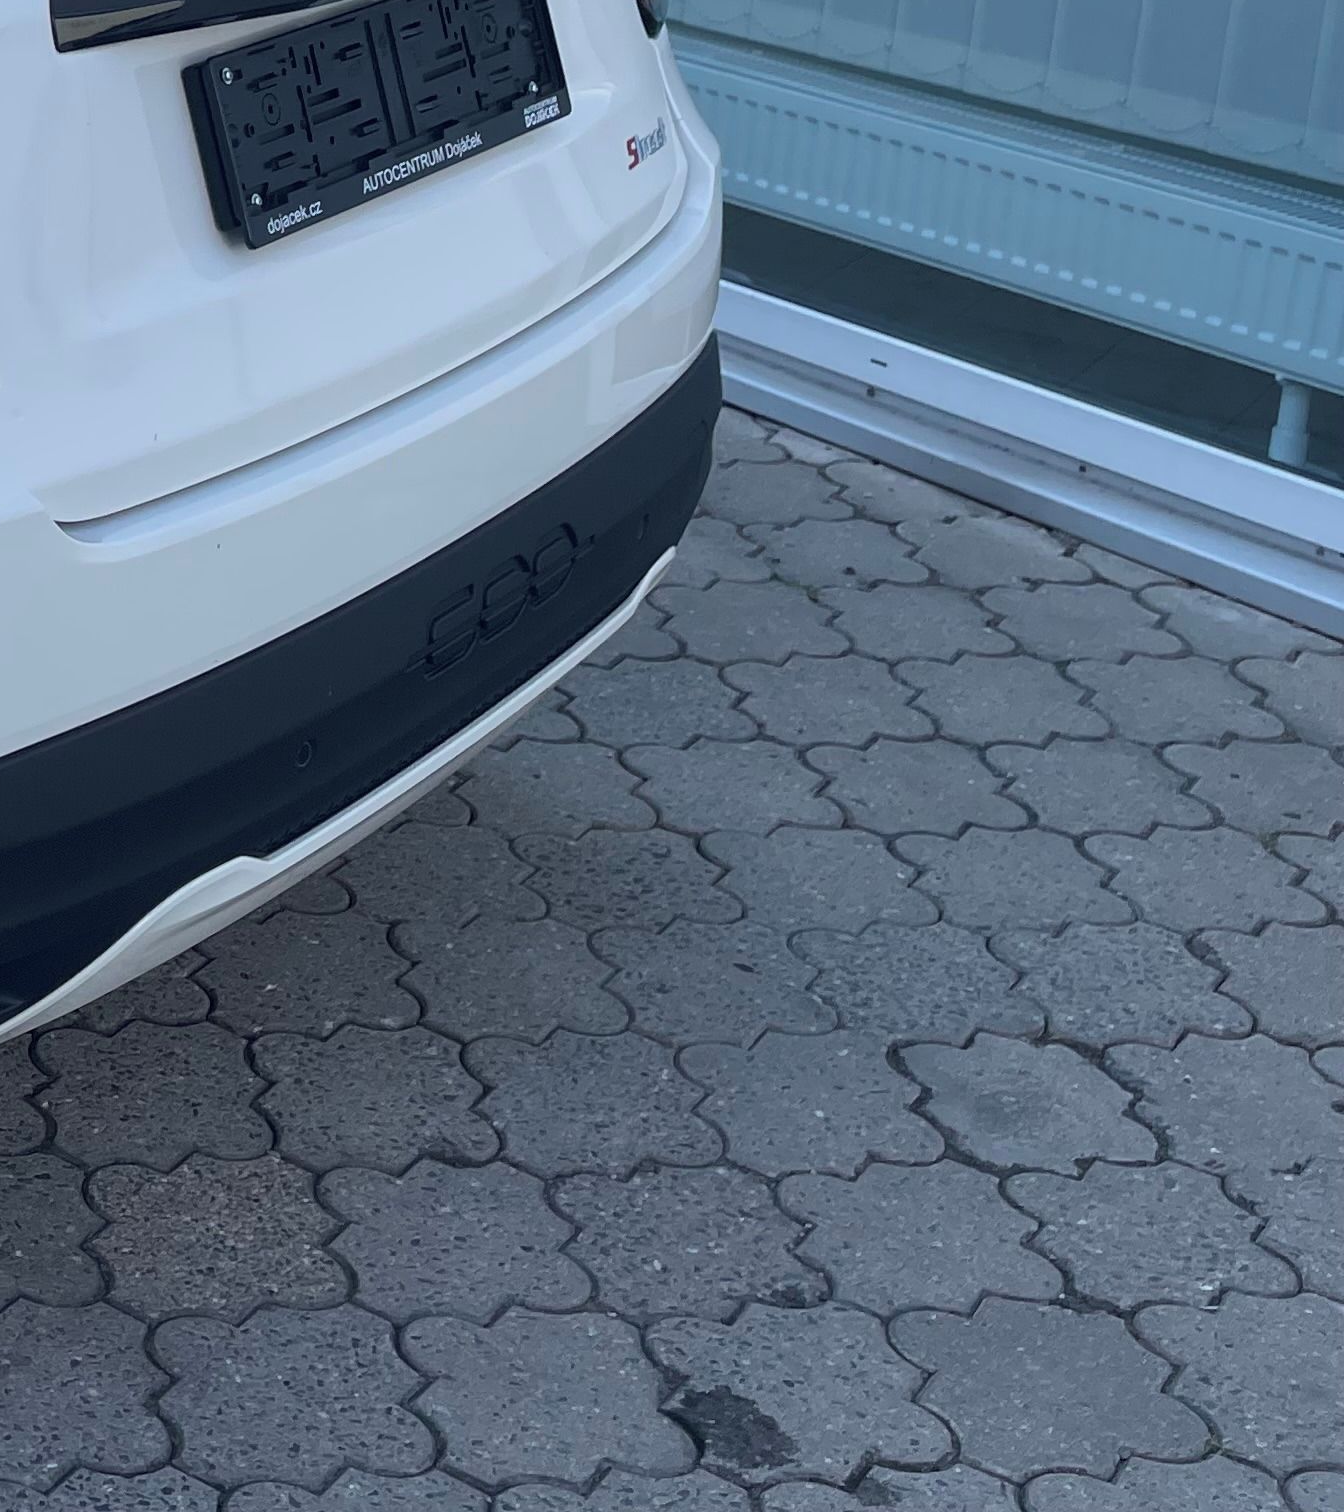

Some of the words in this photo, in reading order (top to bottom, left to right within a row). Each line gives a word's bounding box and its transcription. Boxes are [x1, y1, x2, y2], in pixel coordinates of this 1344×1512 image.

[362, 147, 446, 195] AUTOCENTRUM
[445, 130, 483, 161] Dojáček
[267, 200, 323, 236] dojacek.cz
